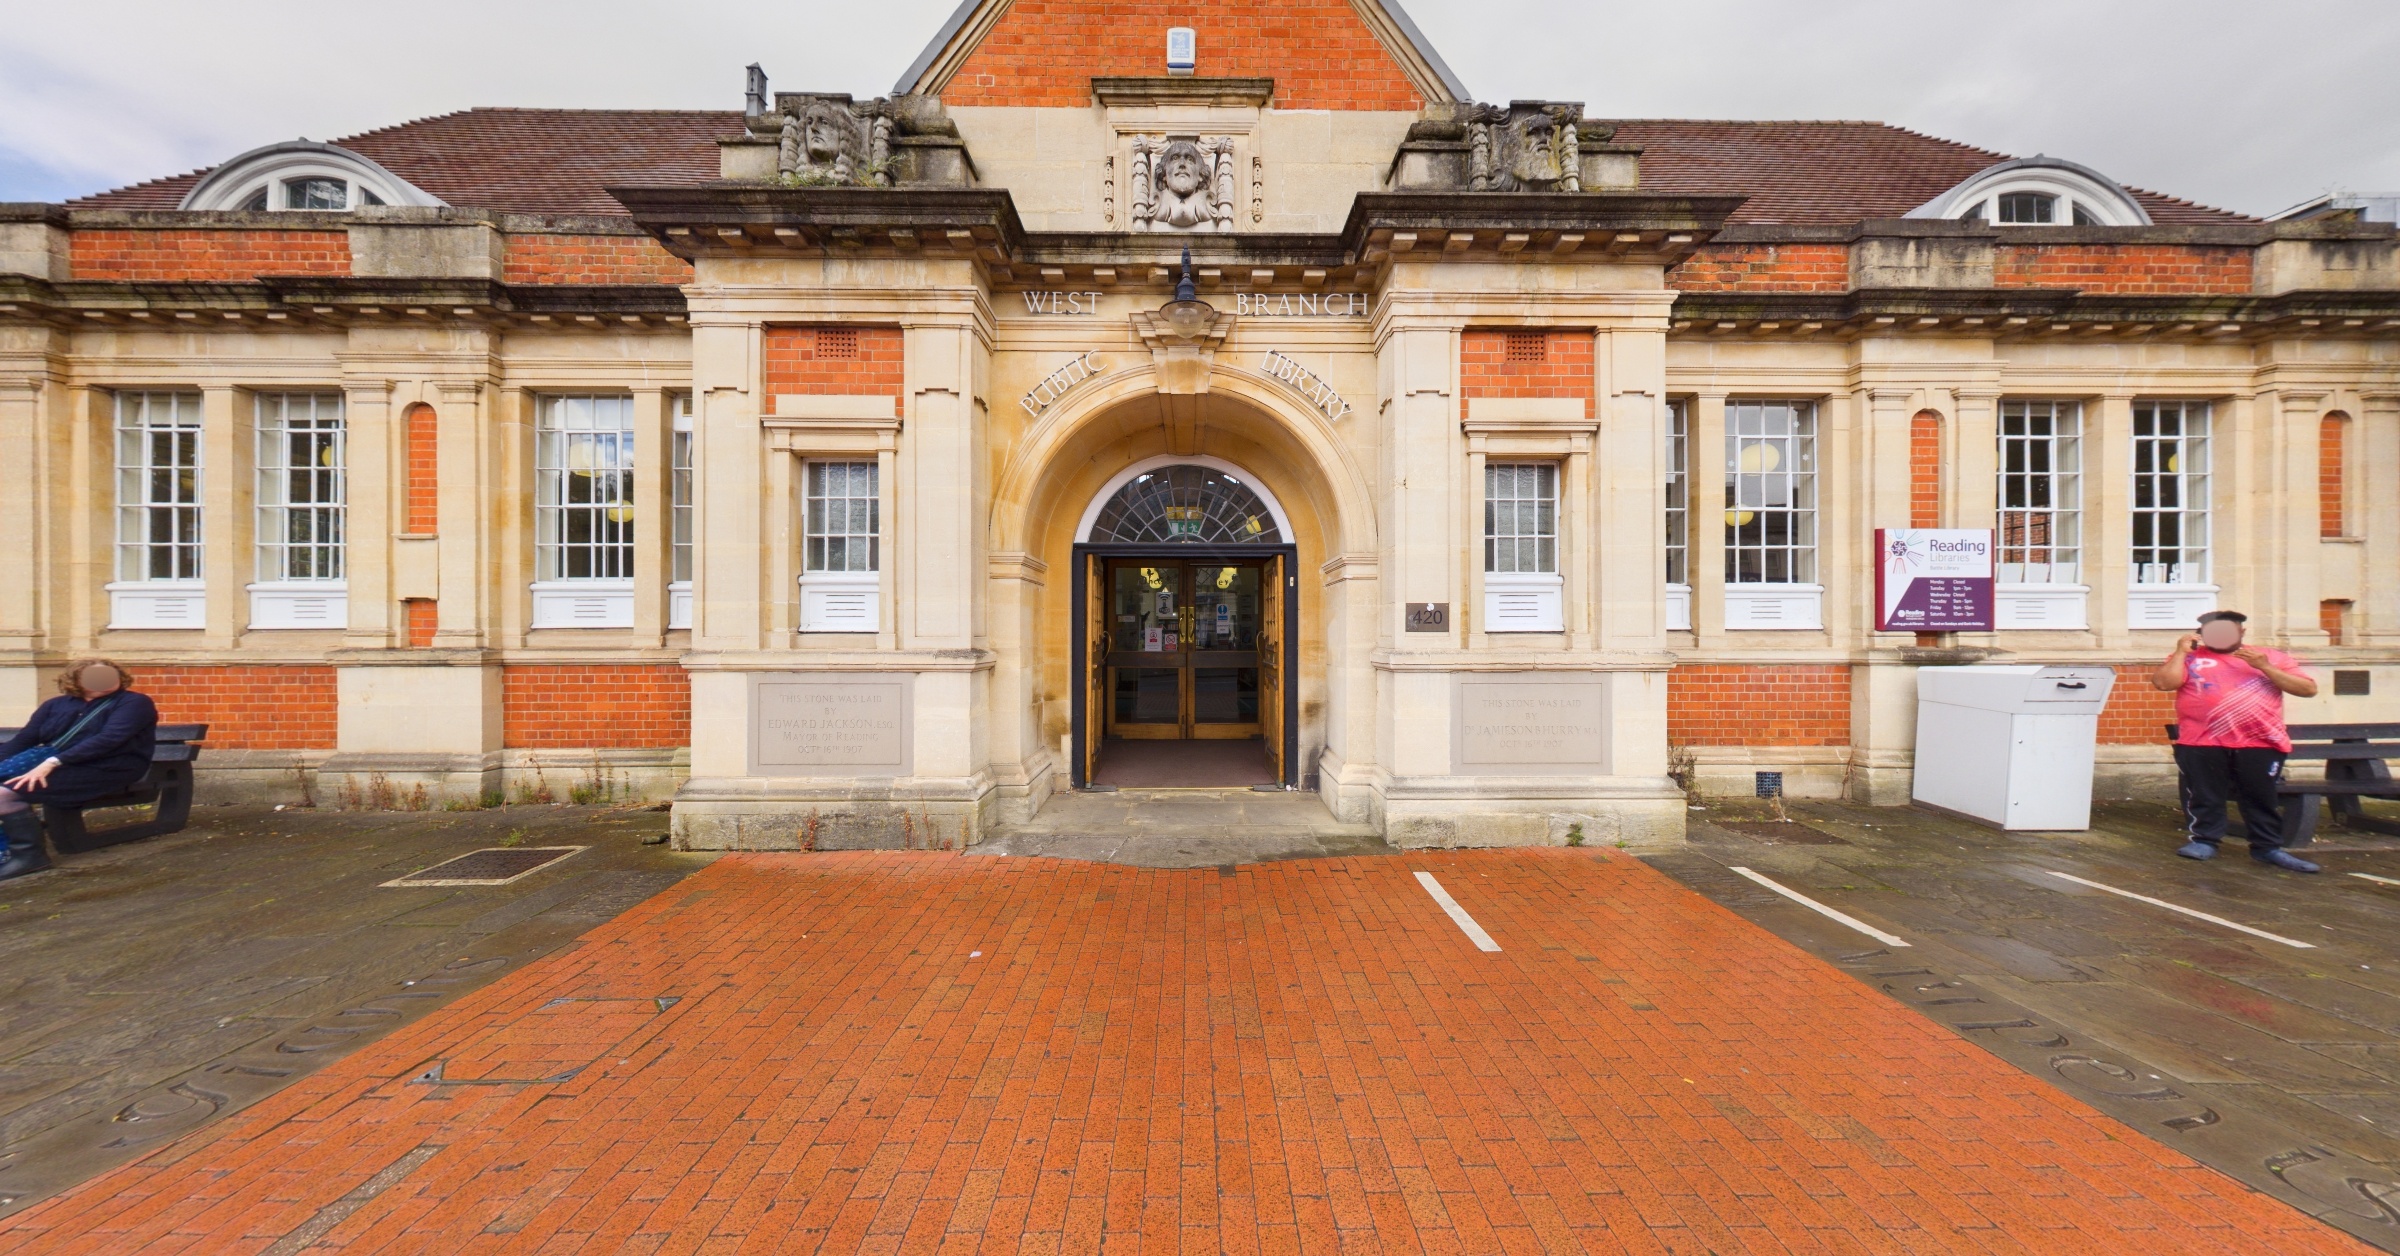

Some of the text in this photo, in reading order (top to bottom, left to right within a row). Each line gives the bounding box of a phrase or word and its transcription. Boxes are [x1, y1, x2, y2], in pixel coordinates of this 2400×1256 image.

[1022, 291, 1369, 316] WEST BRANCH
[1019, 349, 1354, 422] PUBLIC LIBRARY
[1929, 539, 1986, 555] Reading
[1930, 553, 1970, 562] Libraries
[1413, 610, 1443, 625] 420
[780, 695, 882, 703] THIS STONE WAS LAID
[1482, 699, 1582, 708] THIS STONE WAS LAID
[824, 707, 837, 715] BY
[1525, 712, 1538, 720] BY
[768, 719, 817, 729] EDWARD
[821, 733, 832, 741] OF
[843, 745, 863, 754] 1907
[1953, 1019, 2220, 1134] pen
